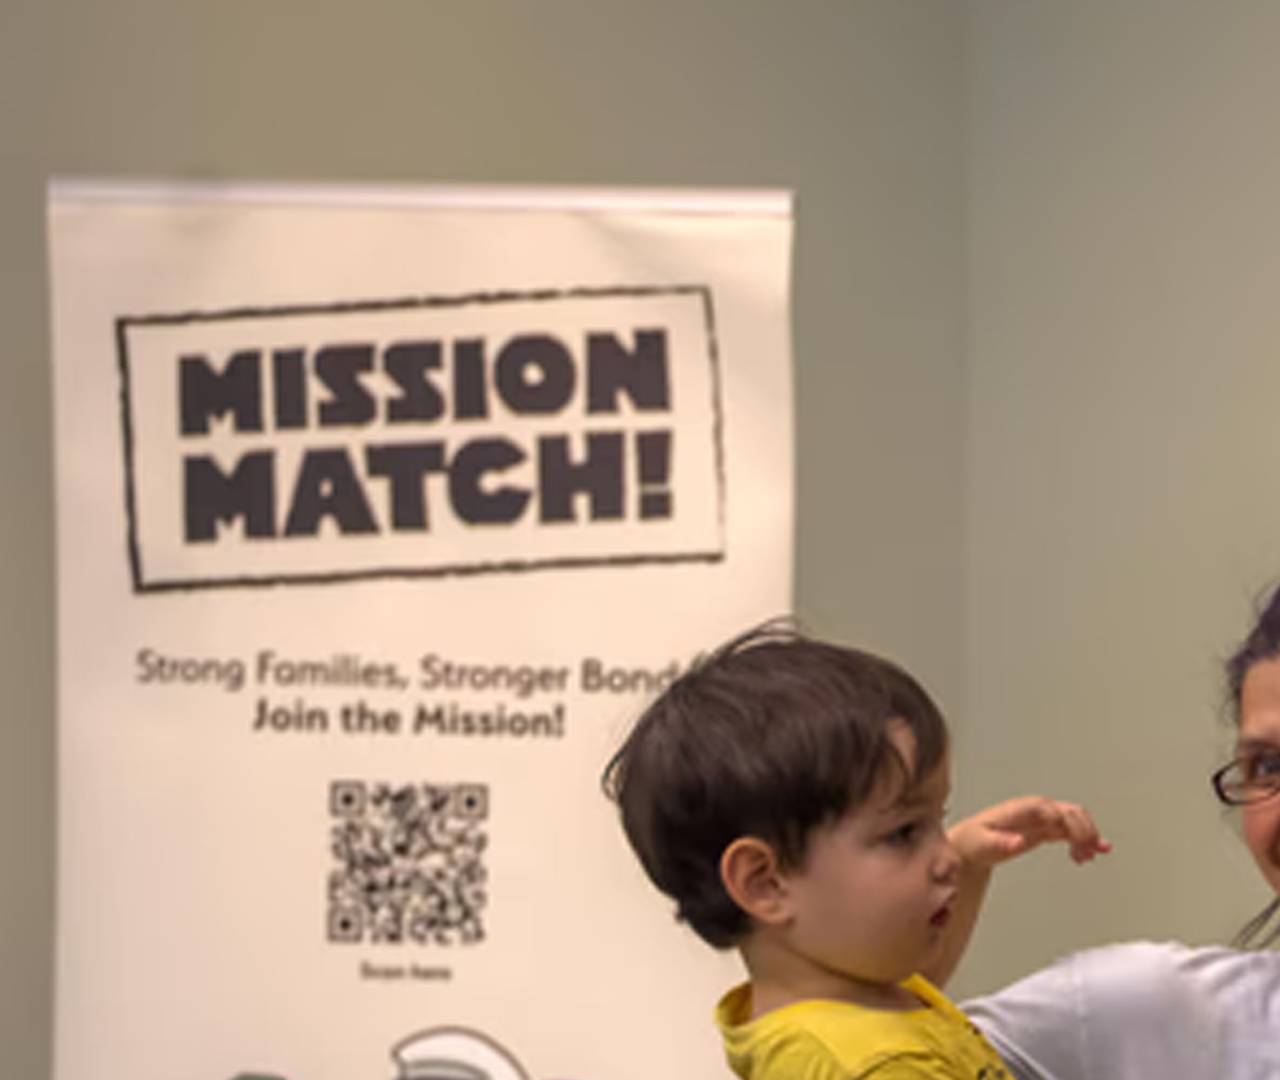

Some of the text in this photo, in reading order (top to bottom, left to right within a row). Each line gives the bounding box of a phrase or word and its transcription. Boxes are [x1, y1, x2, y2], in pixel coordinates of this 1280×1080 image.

[178, 328, 672, 438] MISSION
[181, 430, 674, 545] MATCH!
[135, 647, 246, 692] Strong
[256, 650, 409, 691] Families,
[420, 653, 569, 699] Stronger
[253, 698, 566, 738] Join the Mission!
